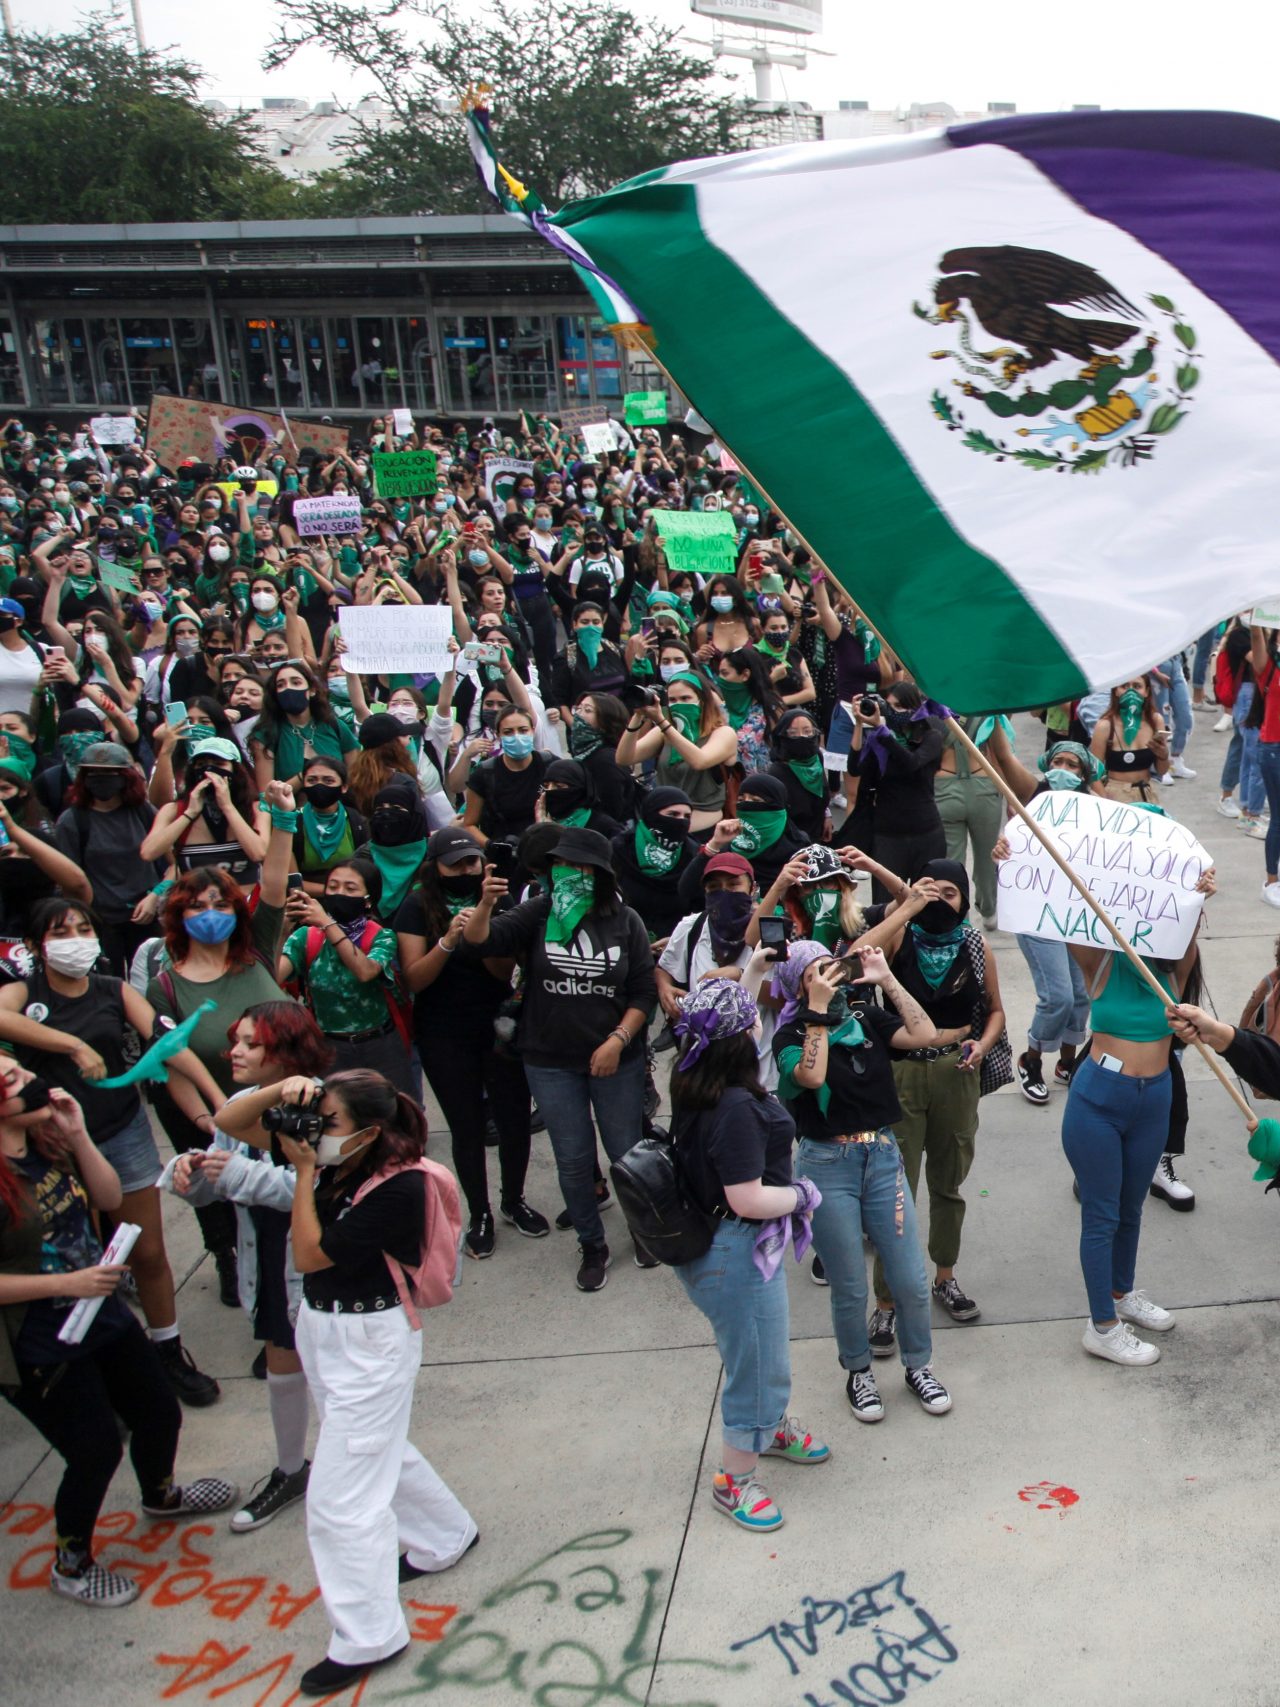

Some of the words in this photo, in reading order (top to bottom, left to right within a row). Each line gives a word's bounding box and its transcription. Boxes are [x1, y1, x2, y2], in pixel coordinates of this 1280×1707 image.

[673, 536, 693, 554] NO
[701, 538, 725, 552] UNA
[1096, 802, 1153, 839] VIDA
[1058, 832, 1133, 875] SALVA
[999, 859, 1056, 895] CON
[1068, 875, 1180, 923] DEJARLA
[1036, 902, 1155, 953] NACER
[543, 977, 617, 998] adidas
[730, 1569, 917, 1676] LEGAL
